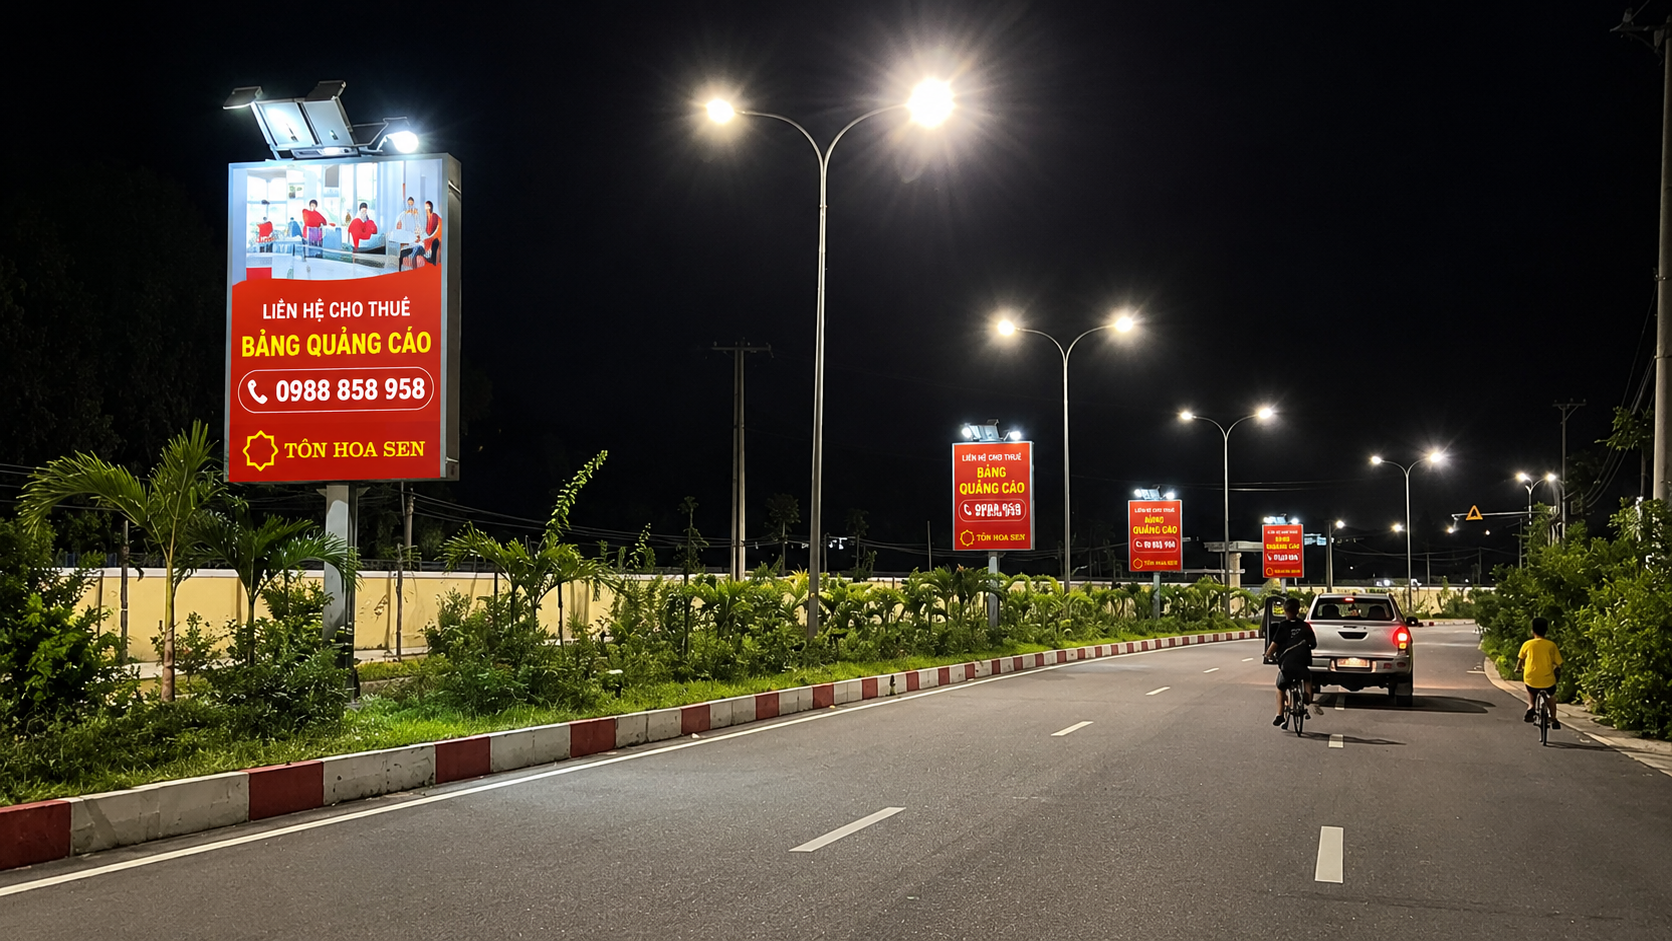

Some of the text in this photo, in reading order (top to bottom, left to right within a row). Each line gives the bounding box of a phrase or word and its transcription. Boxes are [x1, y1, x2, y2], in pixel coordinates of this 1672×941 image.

[302, 297, 325, 323] HỆ
[329, 300, 364, 318] CHO
[241, 325, 432, 358] BẢNG QUẢNG CÁO
[275, 377, 426, 402] 0988 858 958
[283, 438, 426, 459] TÔN HOA SEN
[993, 533, 1009, 541] HOA
